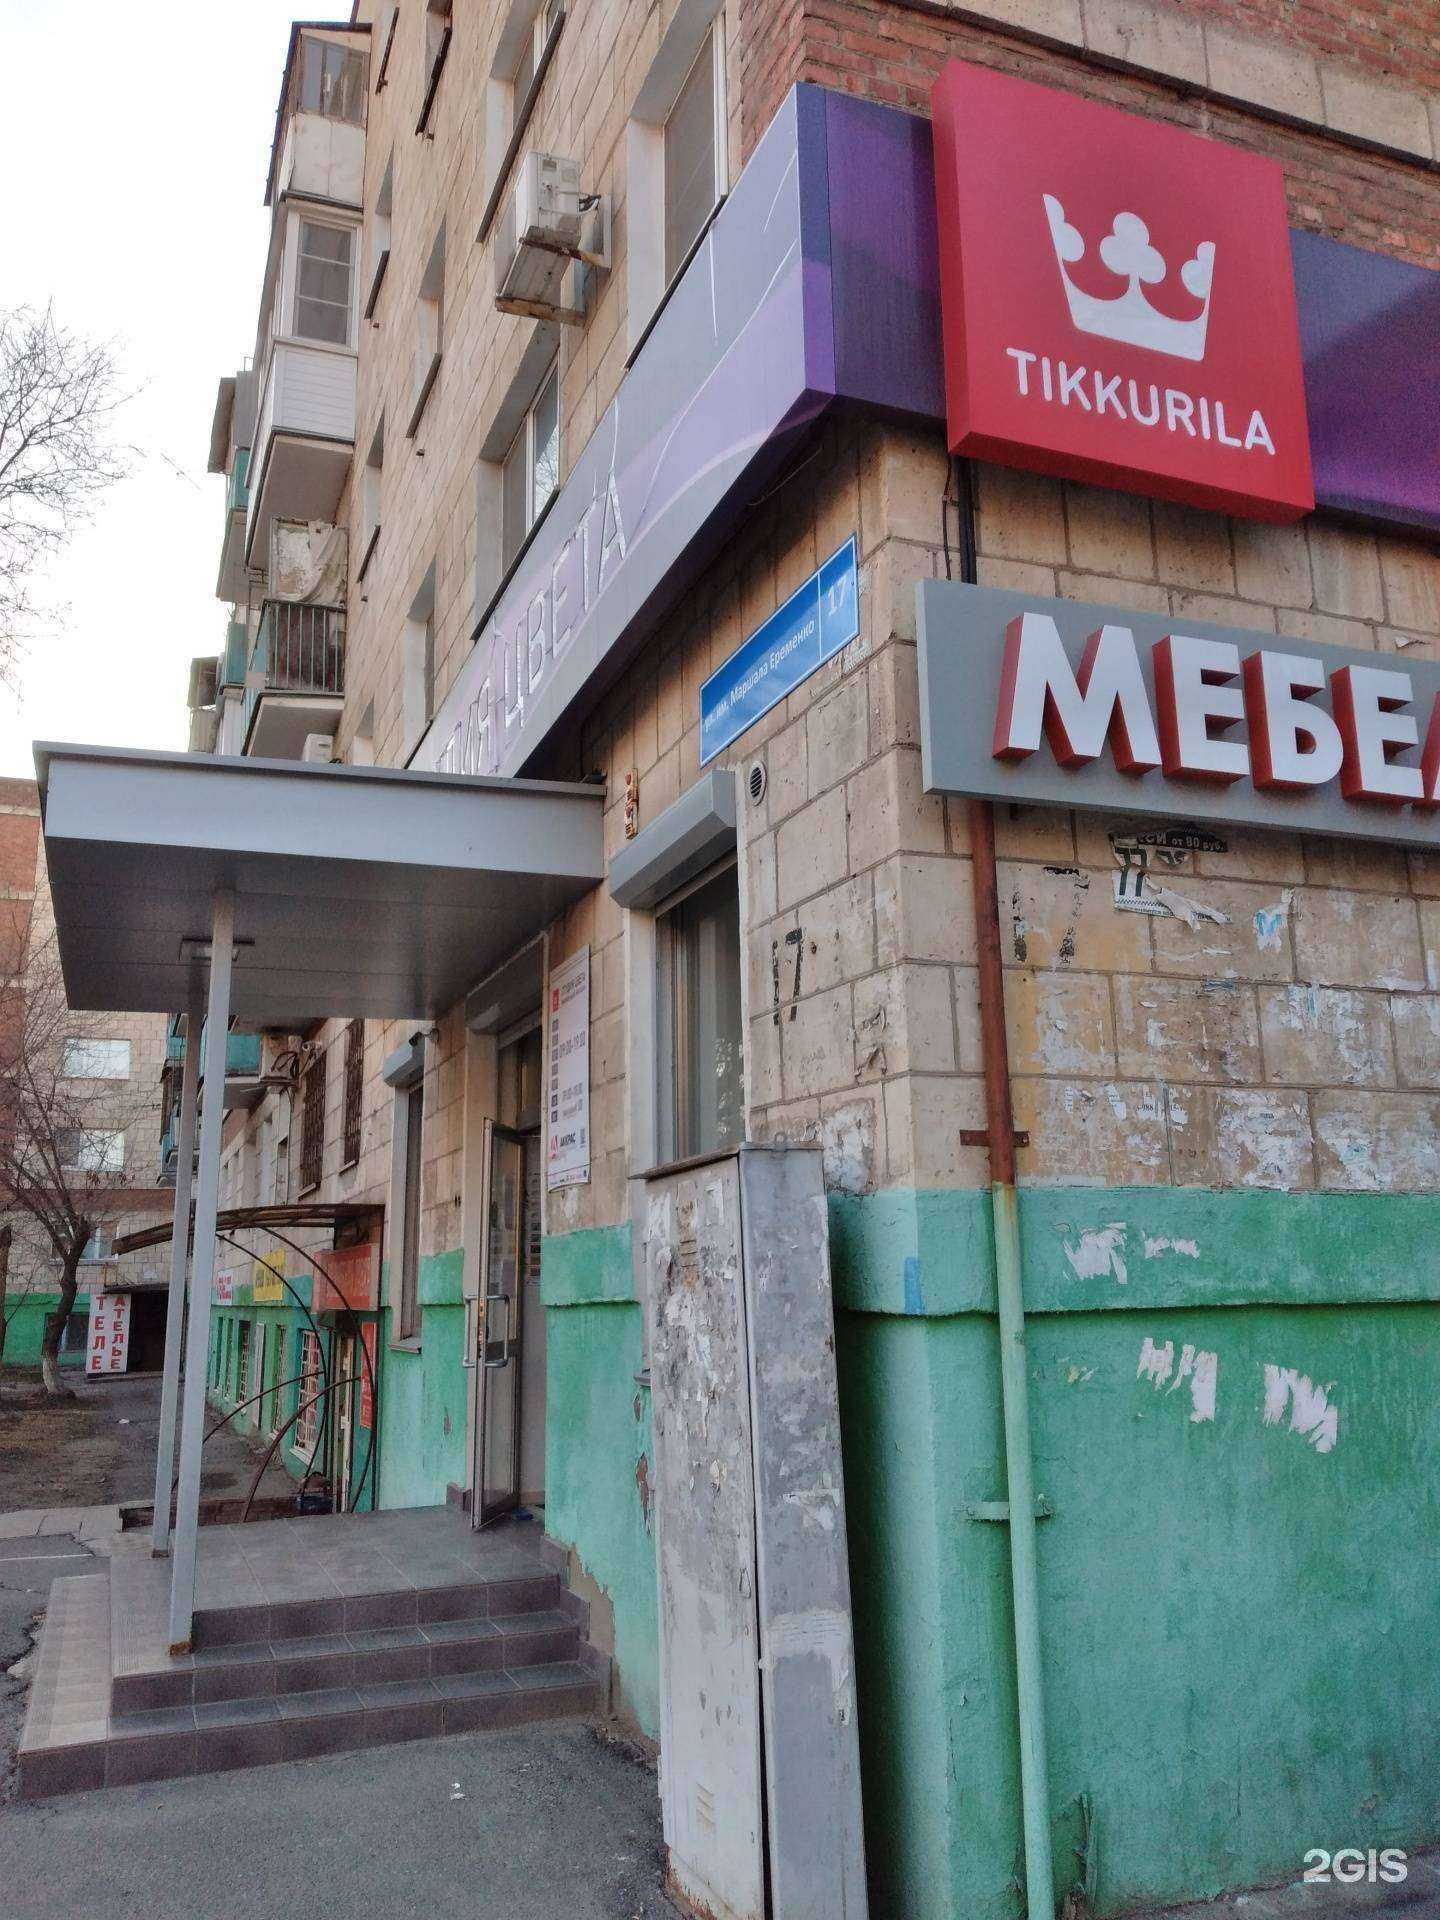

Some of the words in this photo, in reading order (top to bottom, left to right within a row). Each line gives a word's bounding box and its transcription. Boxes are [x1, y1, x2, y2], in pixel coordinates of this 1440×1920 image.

[1006, 347, 1276, 456] TIKKURILA
[503, 470, 627, 729] ЦВЕТА
[827, 576, 847, 617] 17
[730, 662, 768, 707] Маршала
[769, 619, 815, 671] Еременко
[993, 612, 1440, 808] МЕБЕ
[91, 1296, 107, 1370] ТЕЛЕ
[110, 1296, 126, 1370] АТЕЛЬЕ
